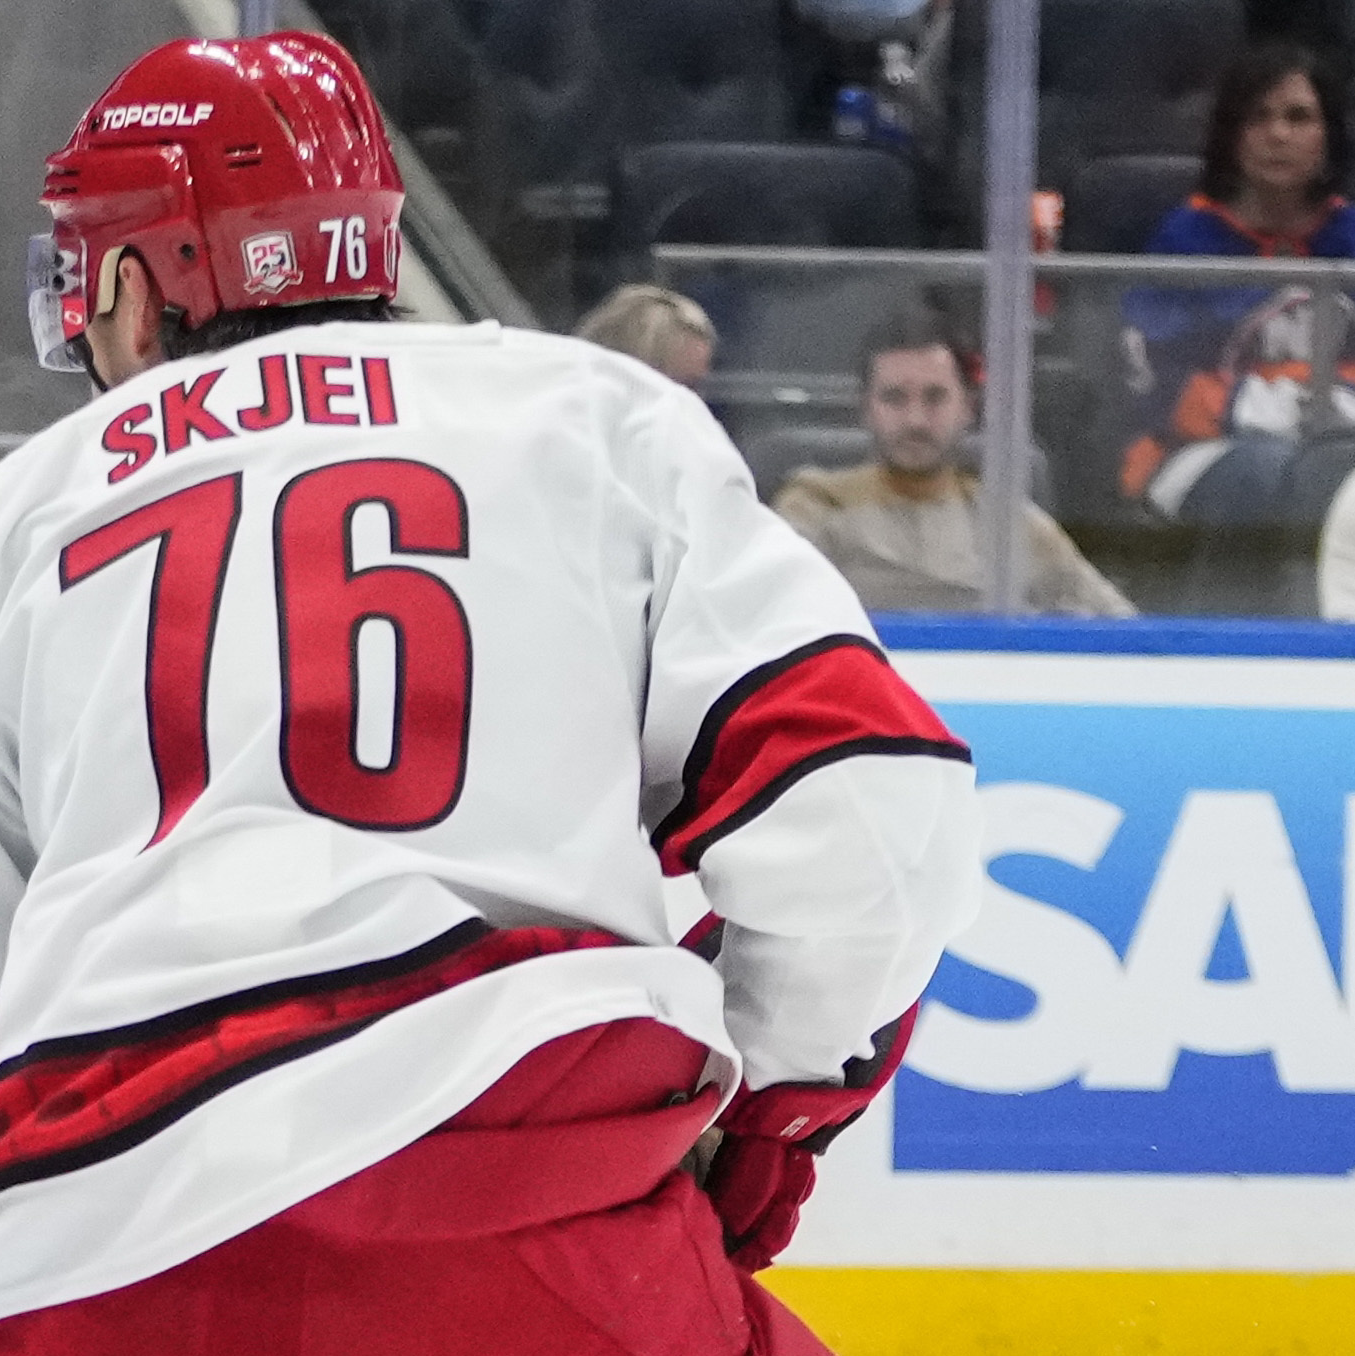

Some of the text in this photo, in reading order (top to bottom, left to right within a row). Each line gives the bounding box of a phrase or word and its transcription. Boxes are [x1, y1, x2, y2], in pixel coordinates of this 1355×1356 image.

[101, 104, 213, 130] TOPGOLF
[319, 215, 368, 283] 76
[101, 353, 400, 486] SKJEI
[60, 457, 473, 857] 76
[902, 780, 1355, 1094] SA
